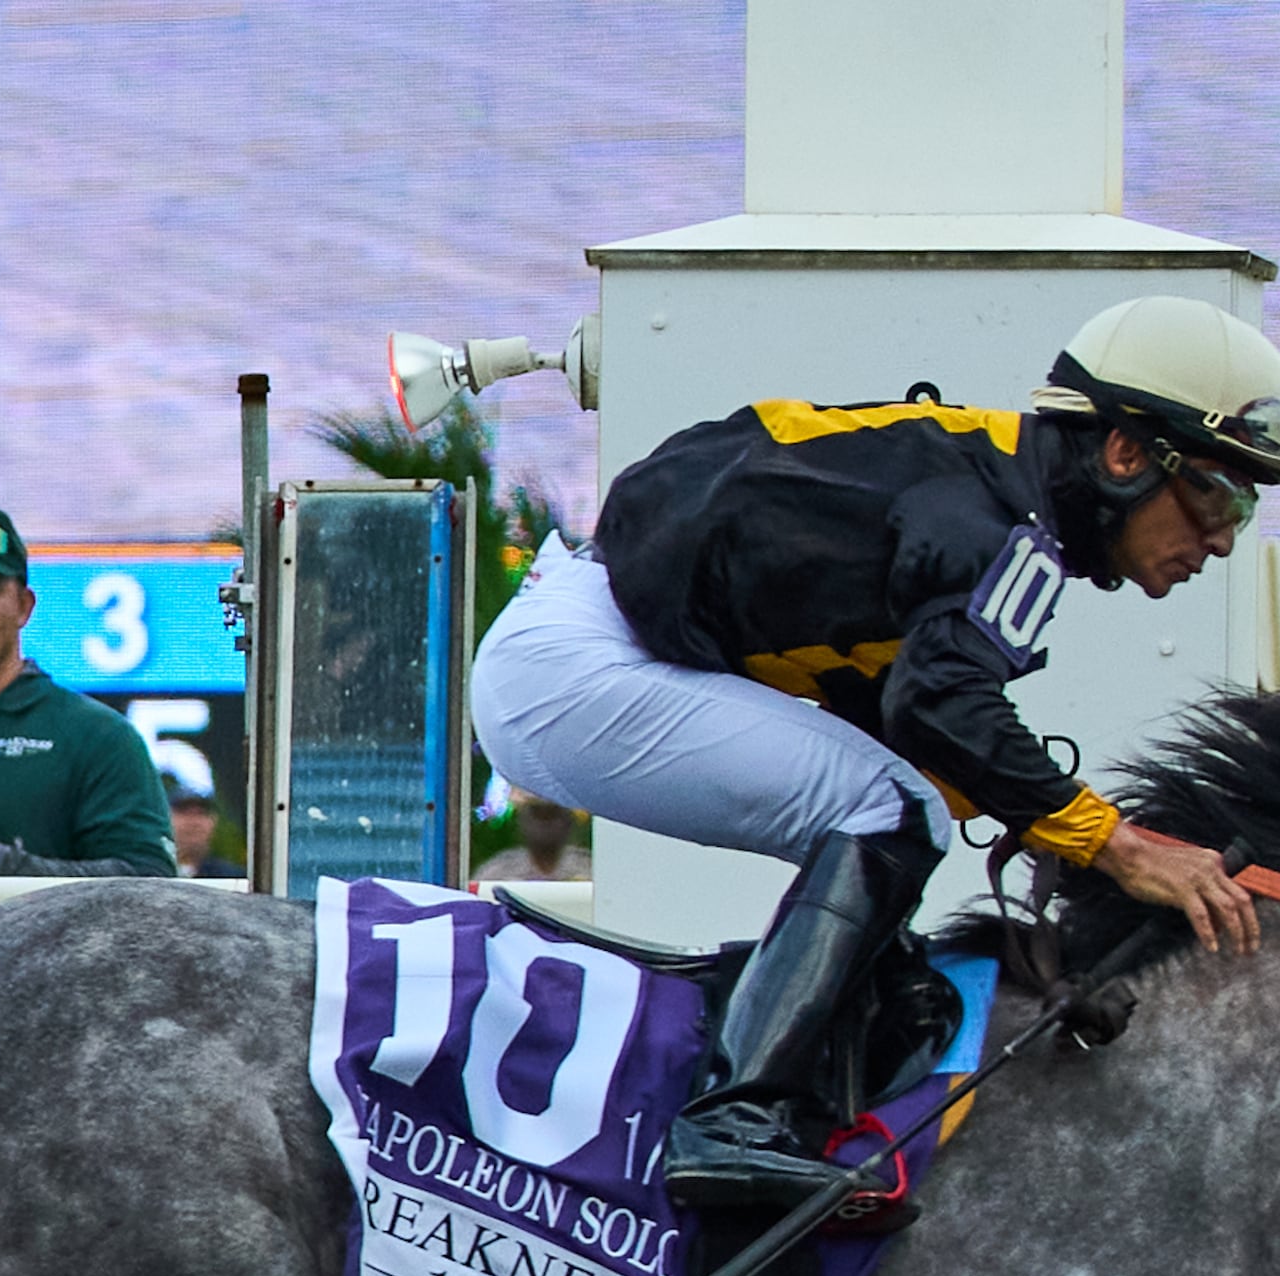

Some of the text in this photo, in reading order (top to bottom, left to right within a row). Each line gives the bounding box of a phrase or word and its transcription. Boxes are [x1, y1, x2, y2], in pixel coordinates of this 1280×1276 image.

[82, 572, 149, 673] 3
[980, 536, 1062, 648] 10
[370, 913, 641, 1167] 10
[357, 1085, 570, 1229] APOLEON
